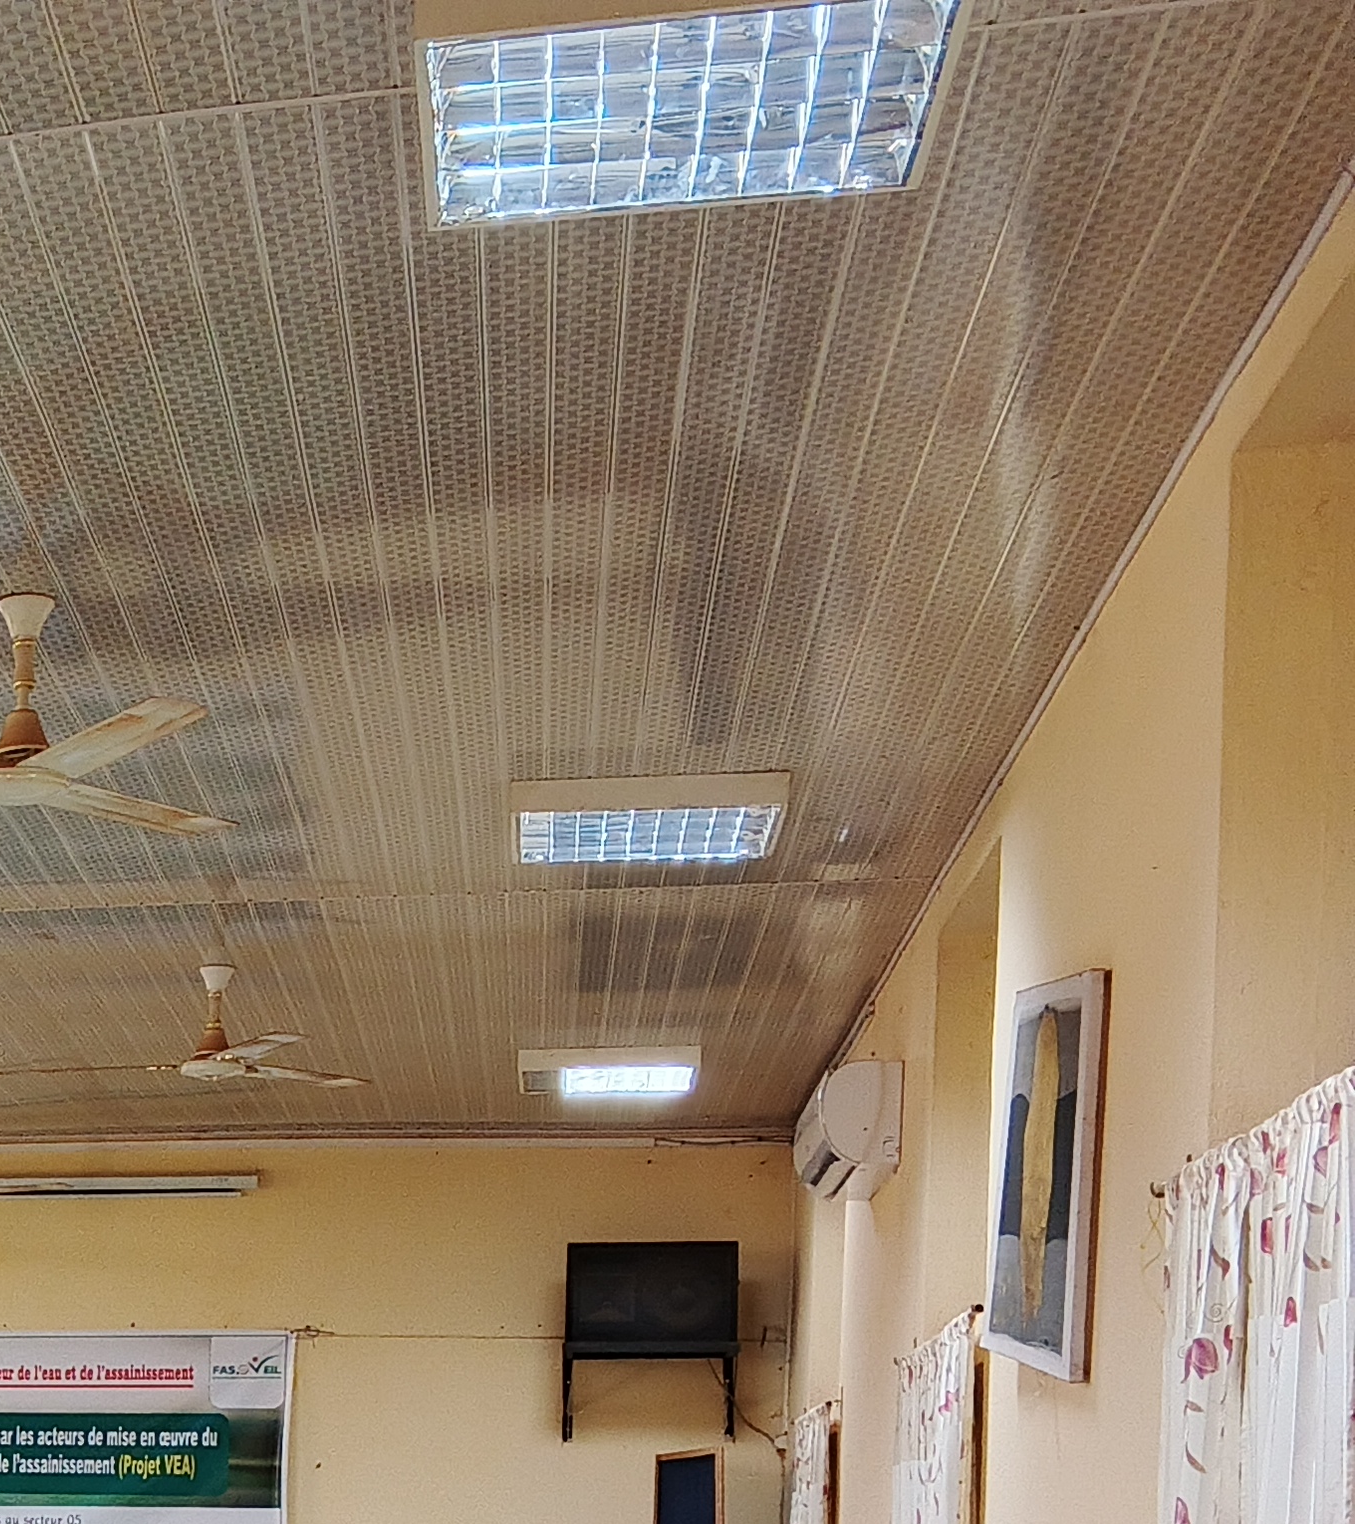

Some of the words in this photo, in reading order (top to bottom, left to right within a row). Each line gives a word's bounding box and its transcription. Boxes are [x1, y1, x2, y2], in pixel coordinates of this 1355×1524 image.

[17, 1364, 31, 1380] de
[34, 1365, 62, 1380] l'eau
[65, 1366, 77, 1380] et
[79, 1365, 94, 1380] de
[96, 1364, 194, 1380] l'assainissement
[16, 1425, 34, 1445] les
[37, 1427, 85, 1446] acteurs
[87, 1426, 104, 1446] de
[106, 1426, 137, 1446] mise
[140, 1431, 156, 1446] en
[158, 1431, 198, 1447] œuvre
[201, 1426, 218, 1447] du
[12, 1453, 116, 1474] l'assainissement
[118, 1454, 161, 1480] (Projet
[164, 1455, 196, 1480] VEA)
